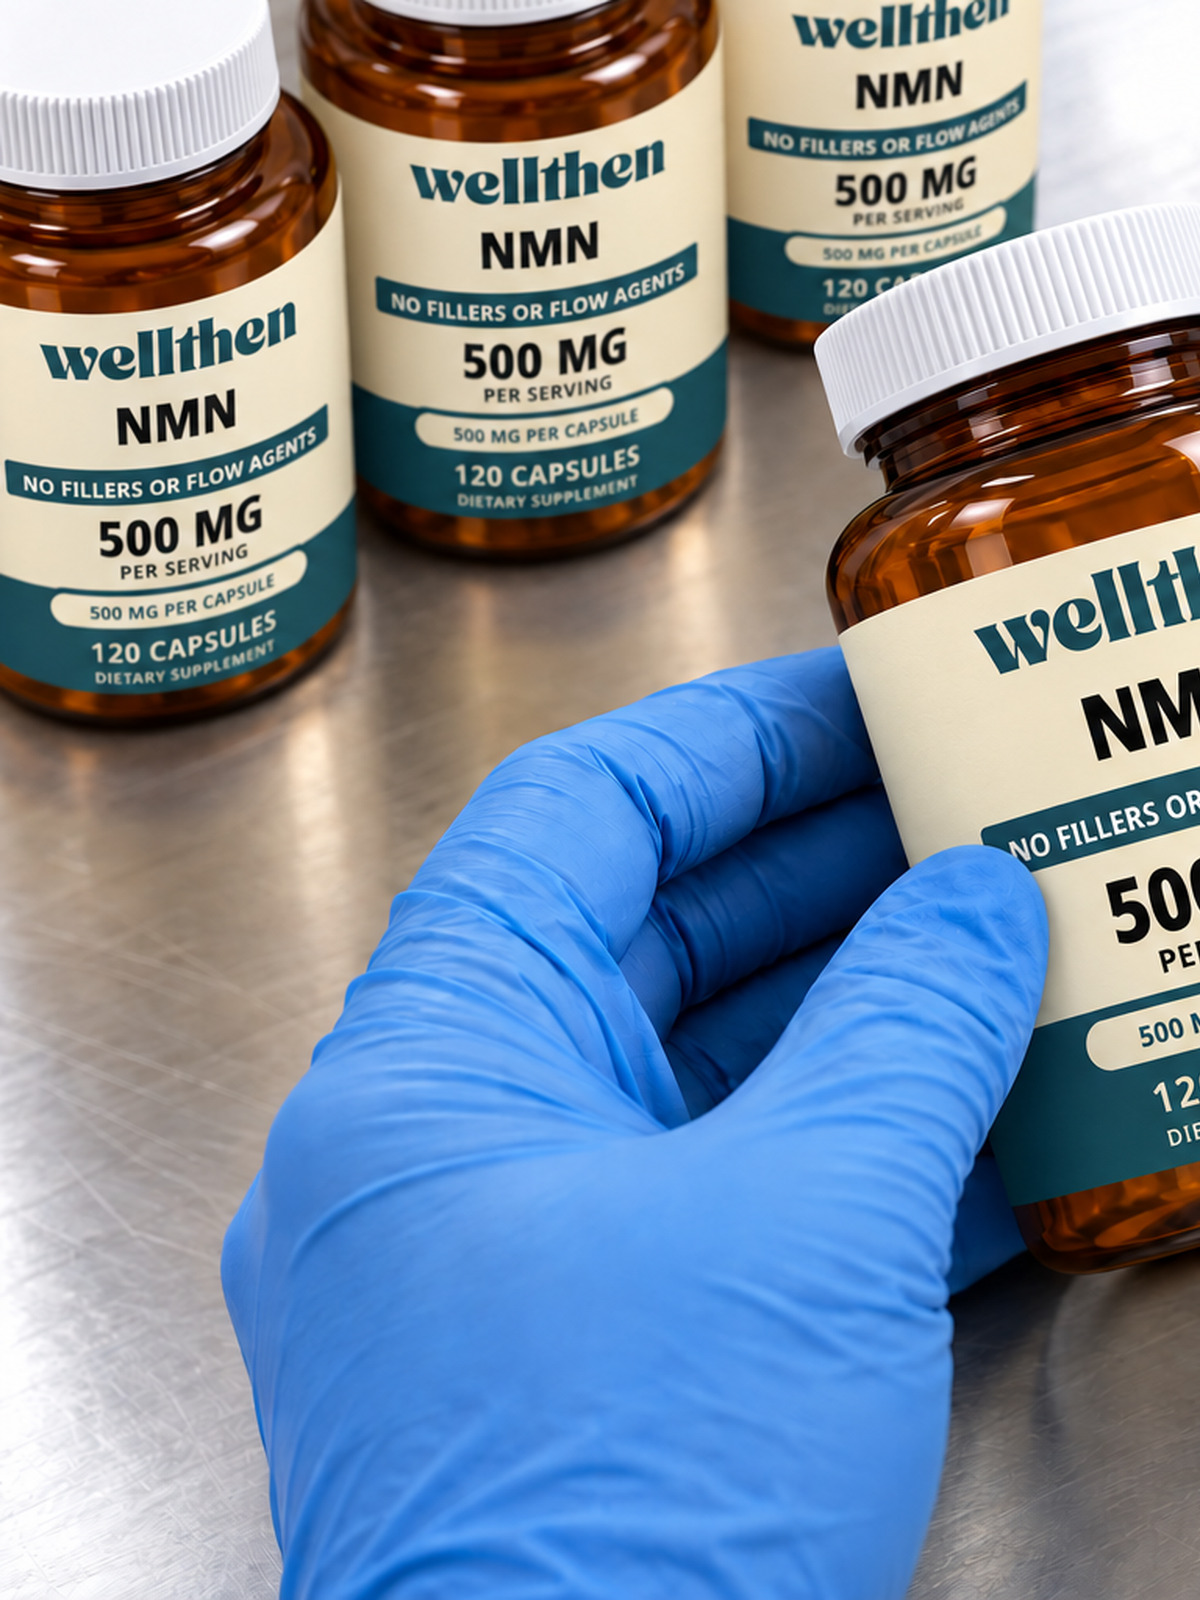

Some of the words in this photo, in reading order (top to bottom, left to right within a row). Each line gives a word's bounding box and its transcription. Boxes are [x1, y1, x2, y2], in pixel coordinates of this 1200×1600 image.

[855, 61, 964, 110] NMN
[763, 131, 794, 150] NO
[800, 137, 877, 156] FILLERS
[882, 137, 912, 154] OR
[915, 126, 967, 151] FLOW
[968, 97, 1020, 137] AGENTS
[410, 140, 665, 205] wellthen
[835, 172, 907, 206] 500
[922, 156, 977, 199] MG
[853, 213, 887, 227] PER
[893, 201, 964, 224] SERVING
[481, 221, 599, 270] NMN
[823, 247, 853, 261] 500
[858, 248, 885, 261] MG
[890, 244, 920, 258] PER
[924, 225, 982, 252] CAPSULE
[391, 293, 421, 313] NO
[427, 300, 507, 322] FILLERS
[513, 303, 544, 321] OR
[550, 293, 608, 318] FLOW
[614, 263, 685, 305] AGENTS
[823, 279, 868, 298] 120
[39, 302, 297, 381] wellthen
[463, 342, 542, 380] 500
[559, 327, 627, 375] MG
[484, 387, 521, 403] PER
[528, 375, 612, 402] SERVING
[116, 389, 237, 446] NMN
[454, 427, 485, 443] 500
[491, 428, 521, 444] MG
[527, 425, 559, 442] PER
[565, 408, 639, 438] CAPSULE
[23, 475, 55, 495] NO
[62, 481, 144, 499] FILLERS
[150, 478, 181, 495] OR
[186, 461, 245, 491] FLOW
[249, 426, 317, 473] AGENTS
[455, 464, 502, 486] 120
[511, 445, 640, 487] CAPSULES
[457, 493, 525, 509] DIETARY
[531, 474, 638, 508] SUPPLEMENT
[99, 519, 179, 558] 500
[195, 495, 263, 547] MG
[120, 564, 158, 580] PER
[165, 544, 249, 576] SERVING
[90, 605, 123, 621] 500
[128, 604, 159, 620] MG
[165, 600, 197, 618] PER
[203, 573, 275, 610] CAPSULE
[92, 642, 141, 664] 120
[150, 610, 277, 661] CAPSULES
[95, 670, 166, 685] DIETARY
[171, 639, 275, 682] SUPPLEMENT
[1008, 832, 1050, 863] NO
[1056, 801, 1160, 850] FILLERS
[1138, 1017, 1184, 1047] 500
